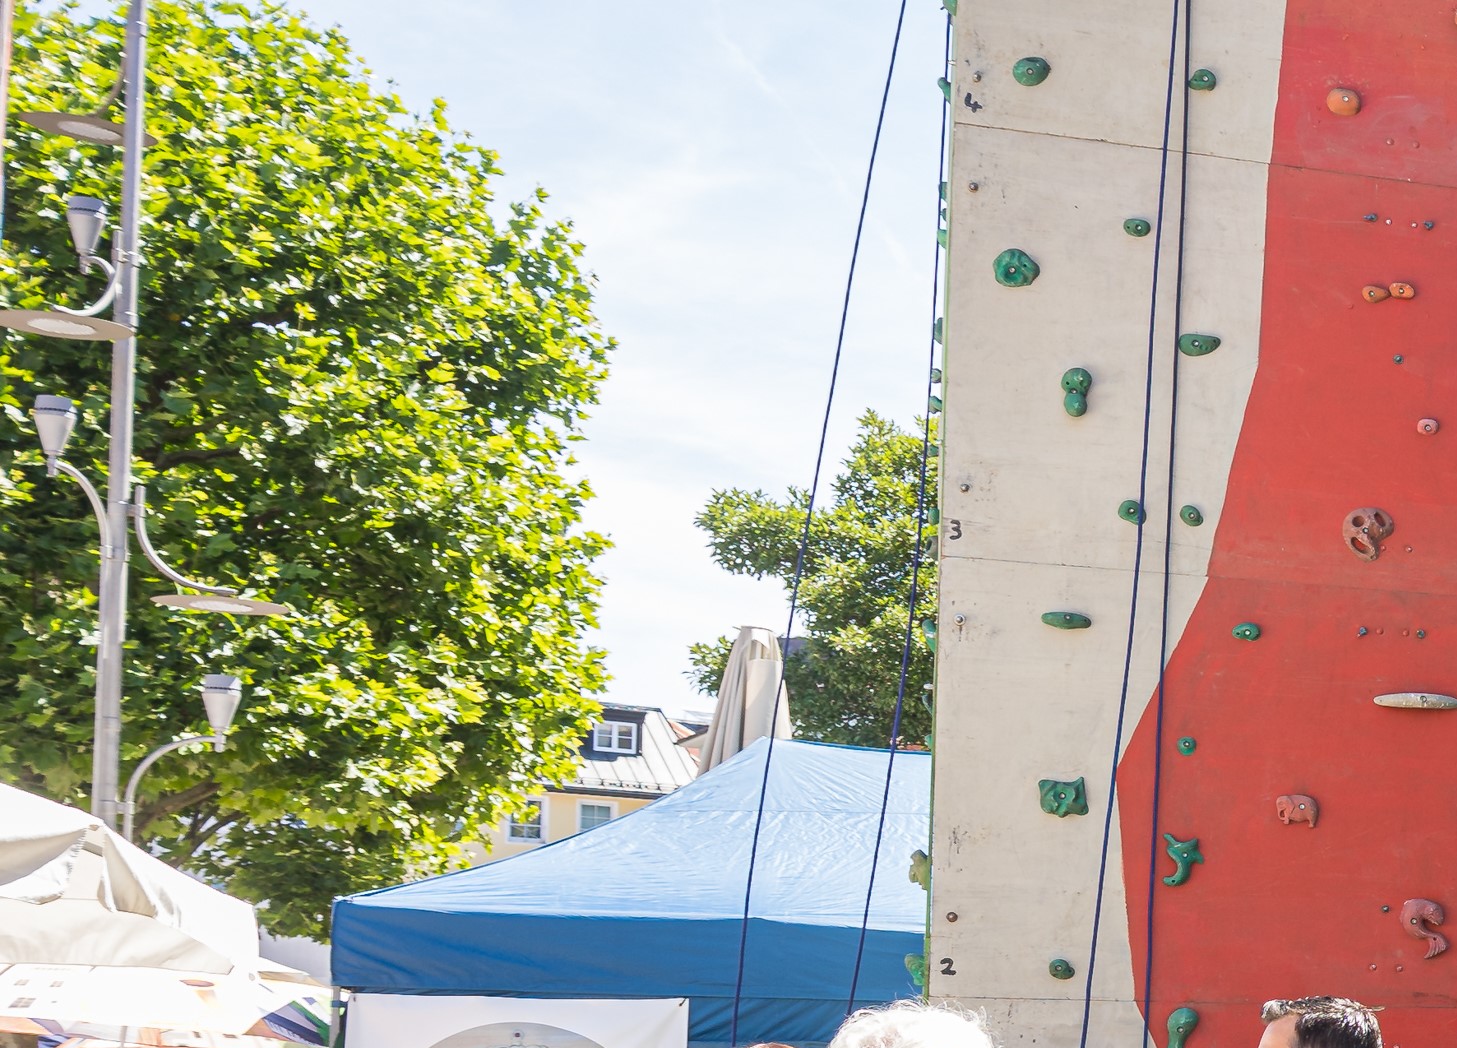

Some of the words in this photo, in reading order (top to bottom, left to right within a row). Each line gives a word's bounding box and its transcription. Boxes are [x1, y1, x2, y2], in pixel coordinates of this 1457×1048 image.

[963, 92, 983, 113] 4
[949, 519, 962, 540] 3
[940, 957, 957, 976] 2
